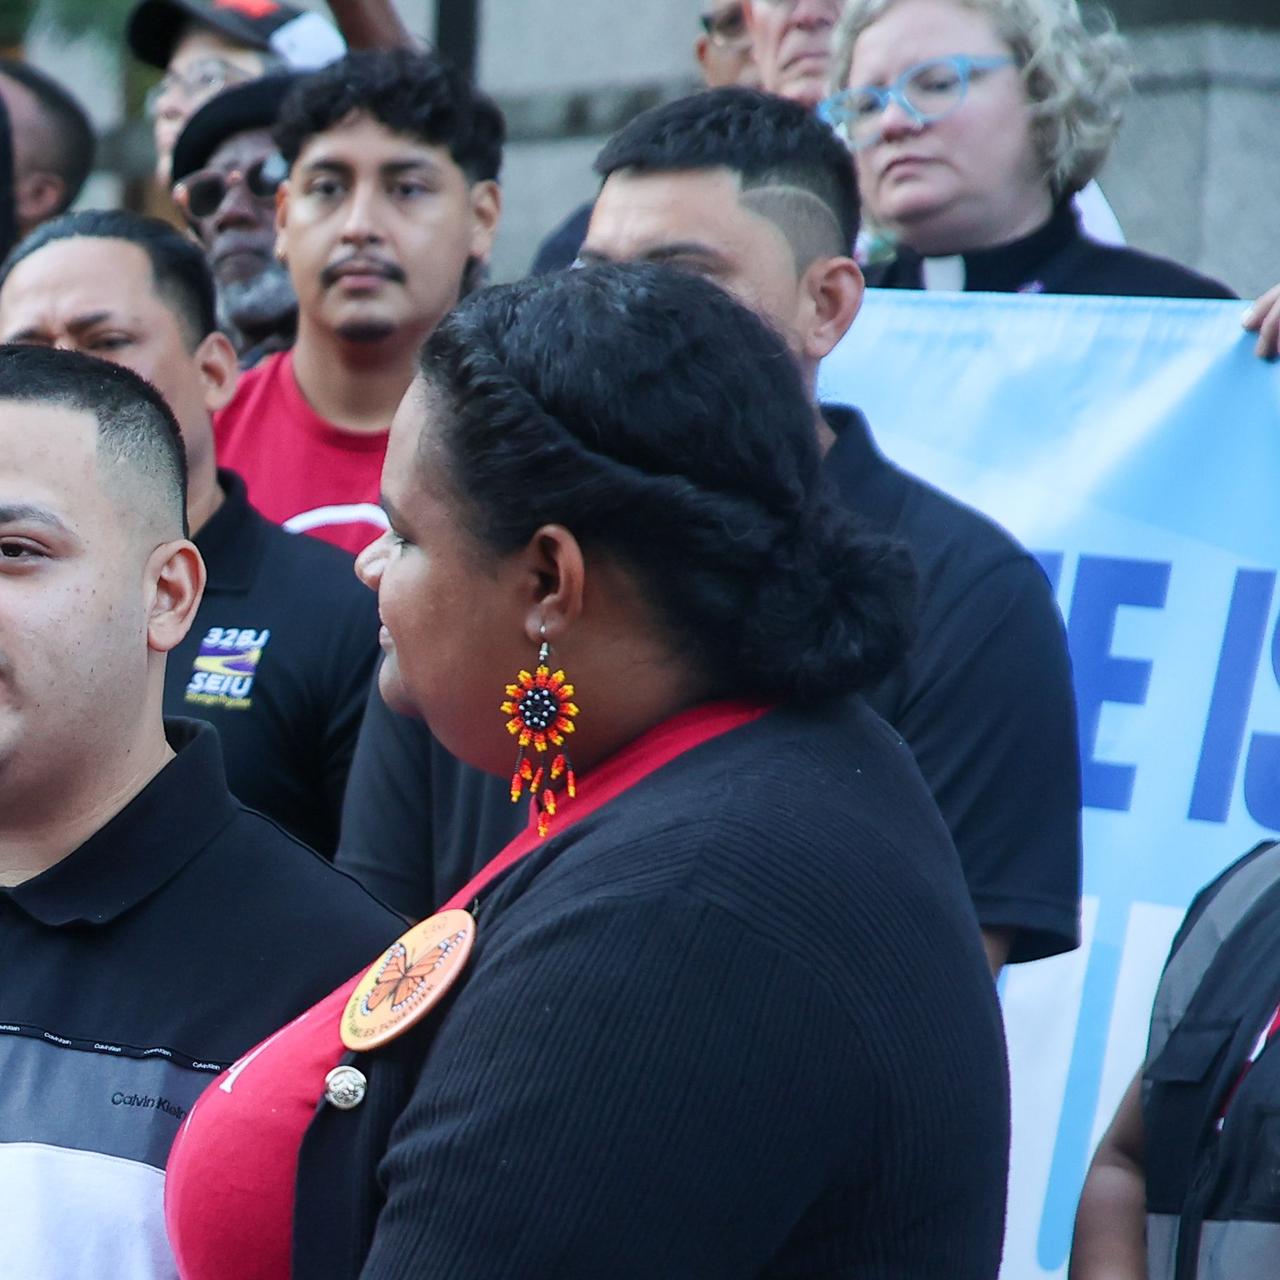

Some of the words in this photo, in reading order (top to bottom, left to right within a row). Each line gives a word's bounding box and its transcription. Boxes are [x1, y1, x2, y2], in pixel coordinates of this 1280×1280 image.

[202, 627, 270, 650] 32BJ
[186, 671, 254, 698] SEIU
[110, 1091, 157, 1110] Calvin
